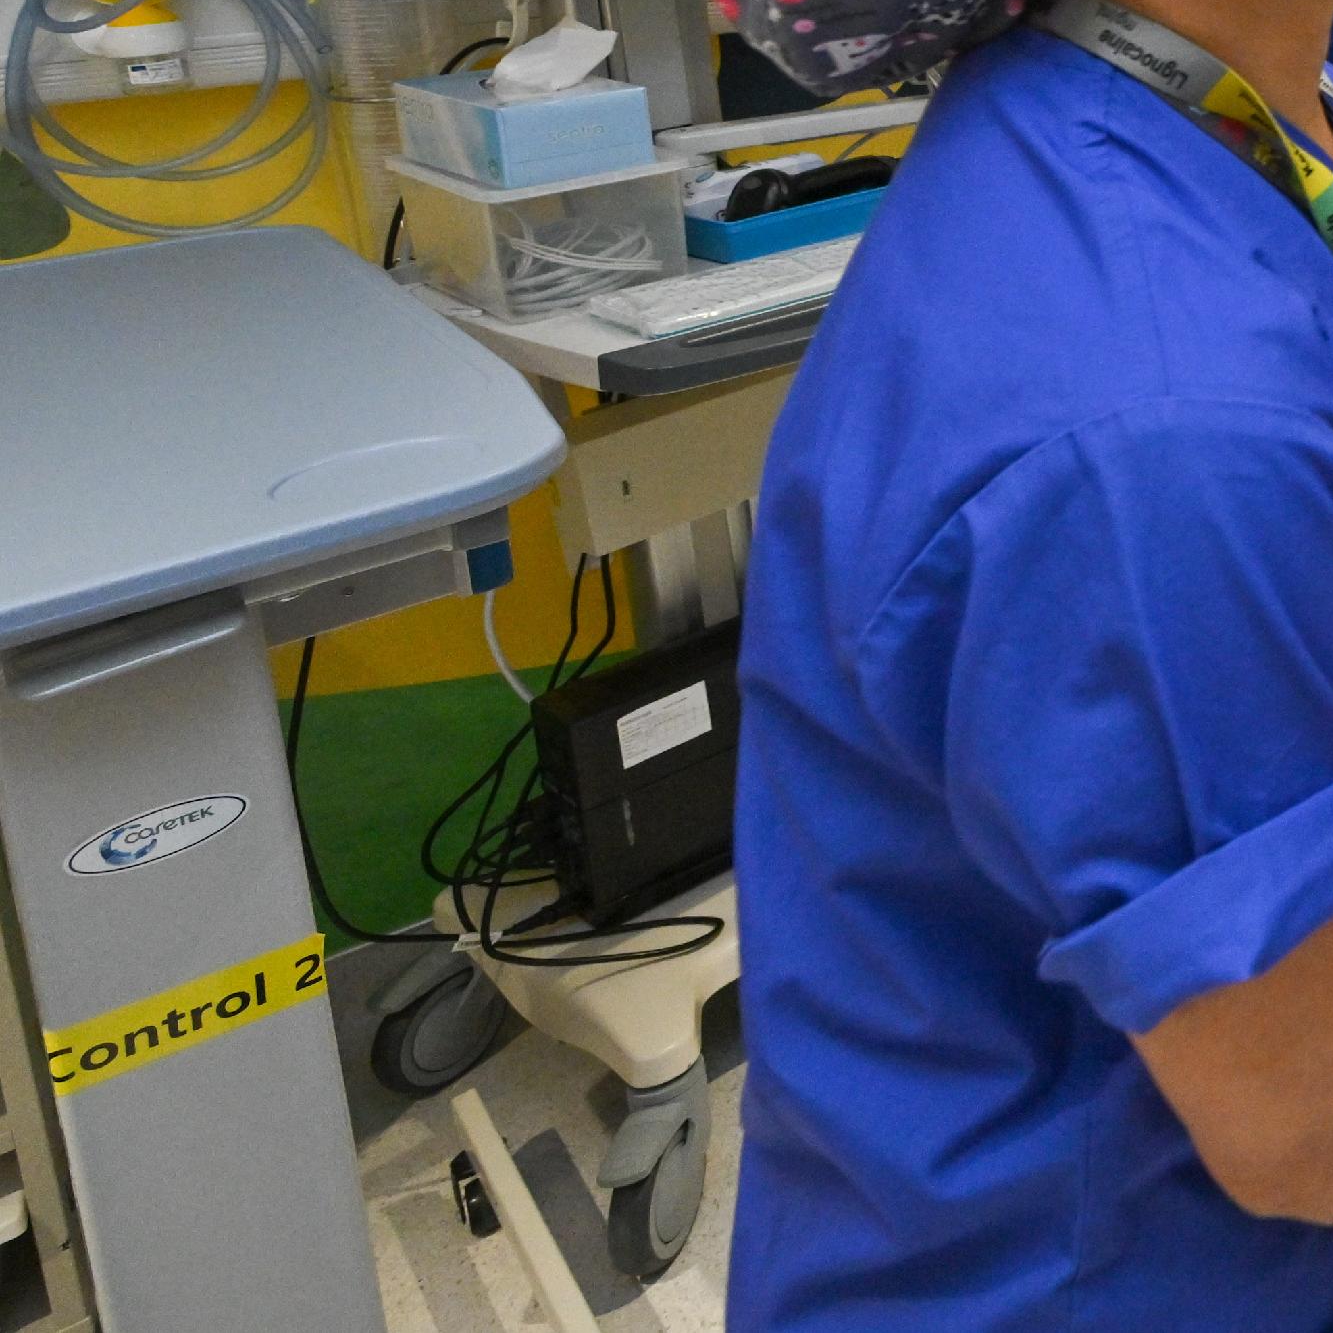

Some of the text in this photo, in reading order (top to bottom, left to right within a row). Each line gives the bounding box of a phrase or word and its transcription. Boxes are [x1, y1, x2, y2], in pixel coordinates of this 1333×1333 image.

[1099, 29, 1188, 90] Lignocaine
[48, 953, 323, 1083] Control 2
